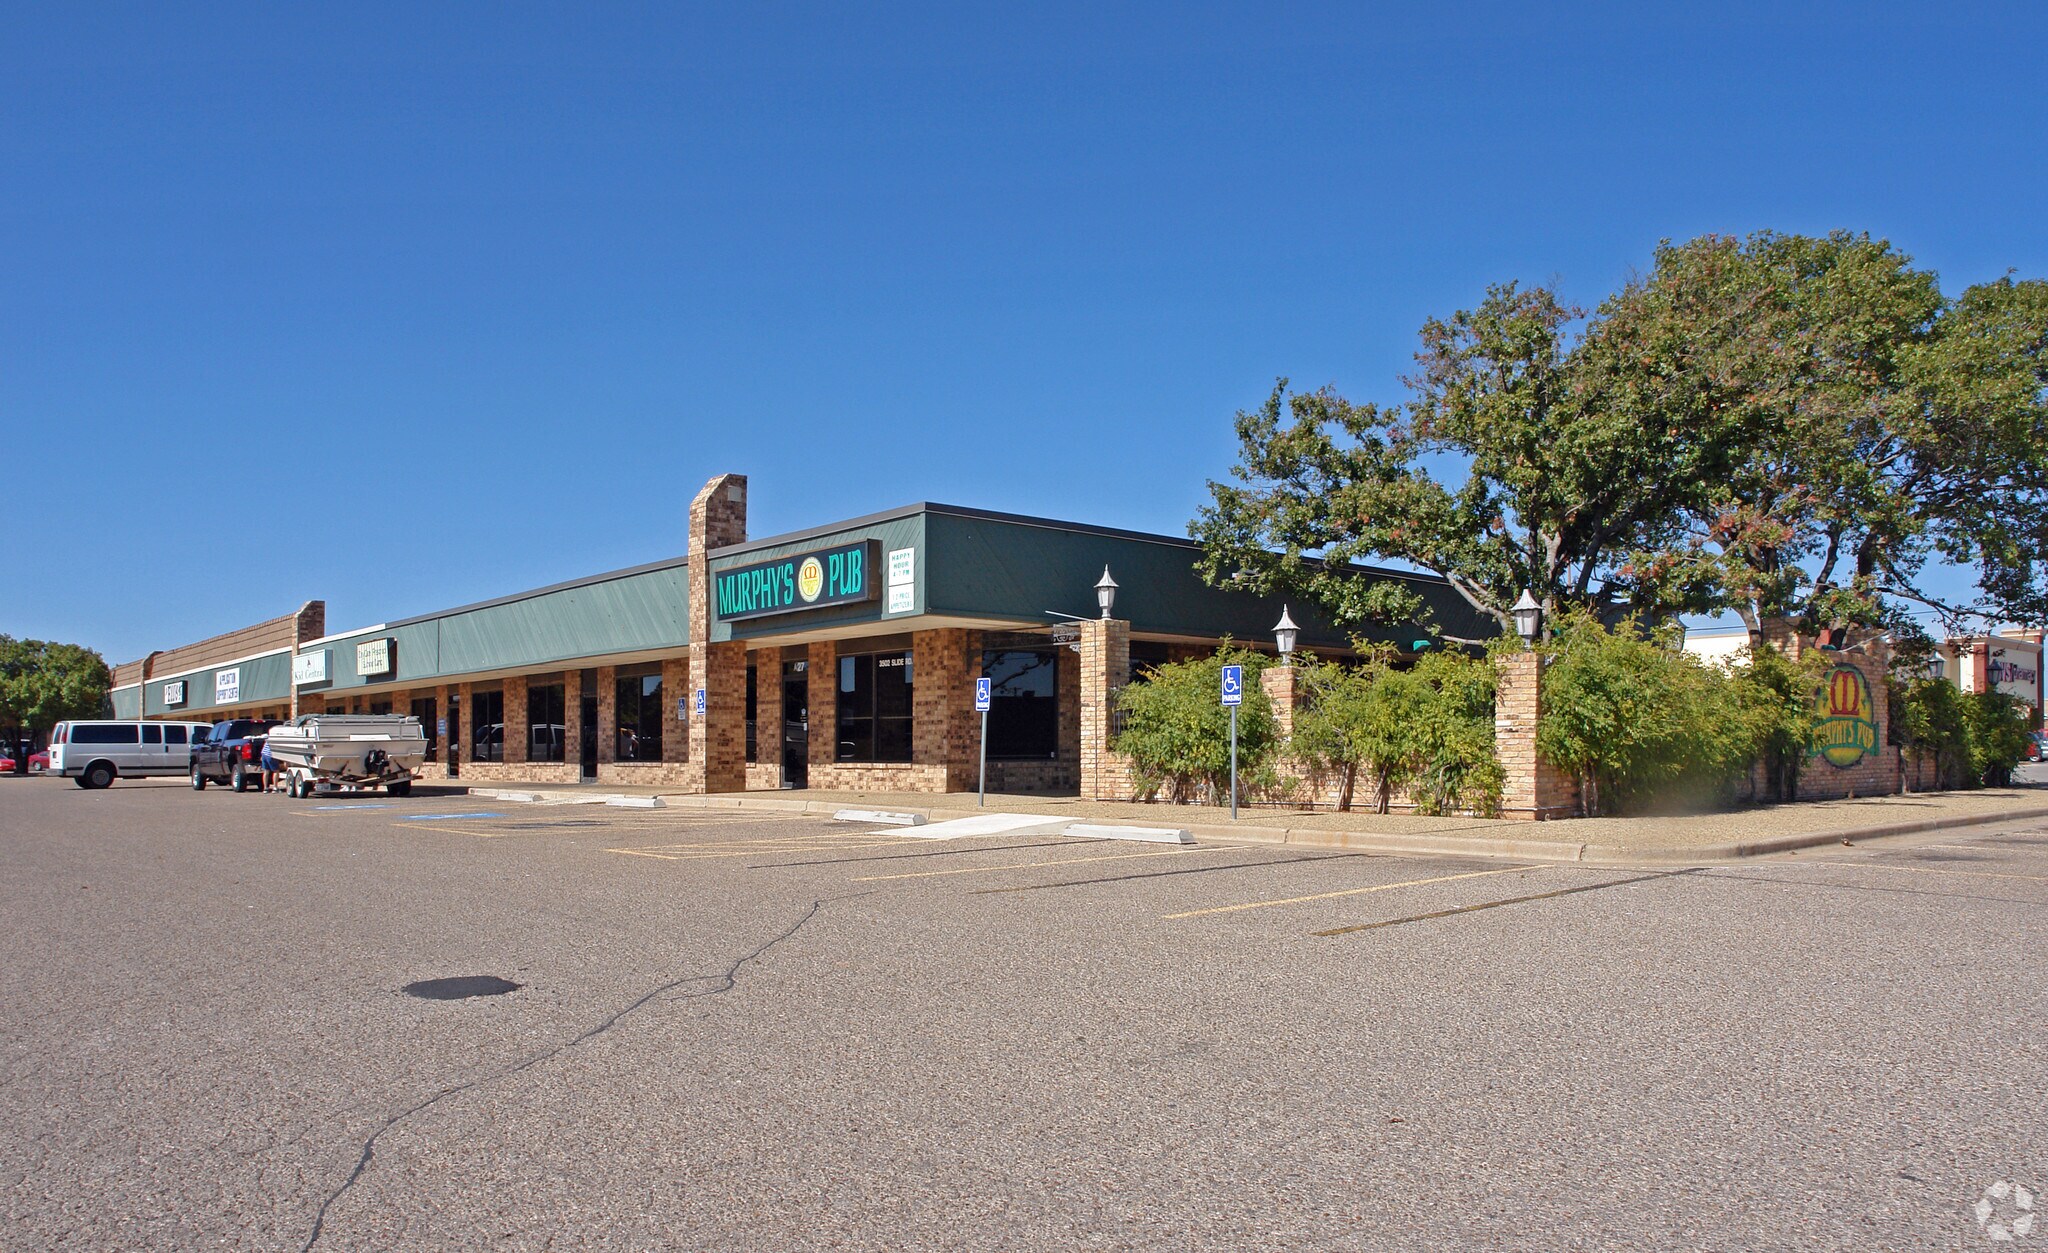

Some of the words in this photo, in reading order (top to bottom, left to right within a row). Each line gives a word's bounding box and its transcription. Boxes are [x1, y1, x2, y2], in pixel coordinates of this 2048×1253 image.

[892, 553, 910, 561] HAPPY
[893, 561, 909, 569] HOUR
[718, 563, 794, 615] MURPHY'S
[828, 549, 862, 597] PUB
[891, 658, 904, 666] SLIDE
[305, 667, 325, 679] Central
[1857, 721, 1874, 749] PUB
